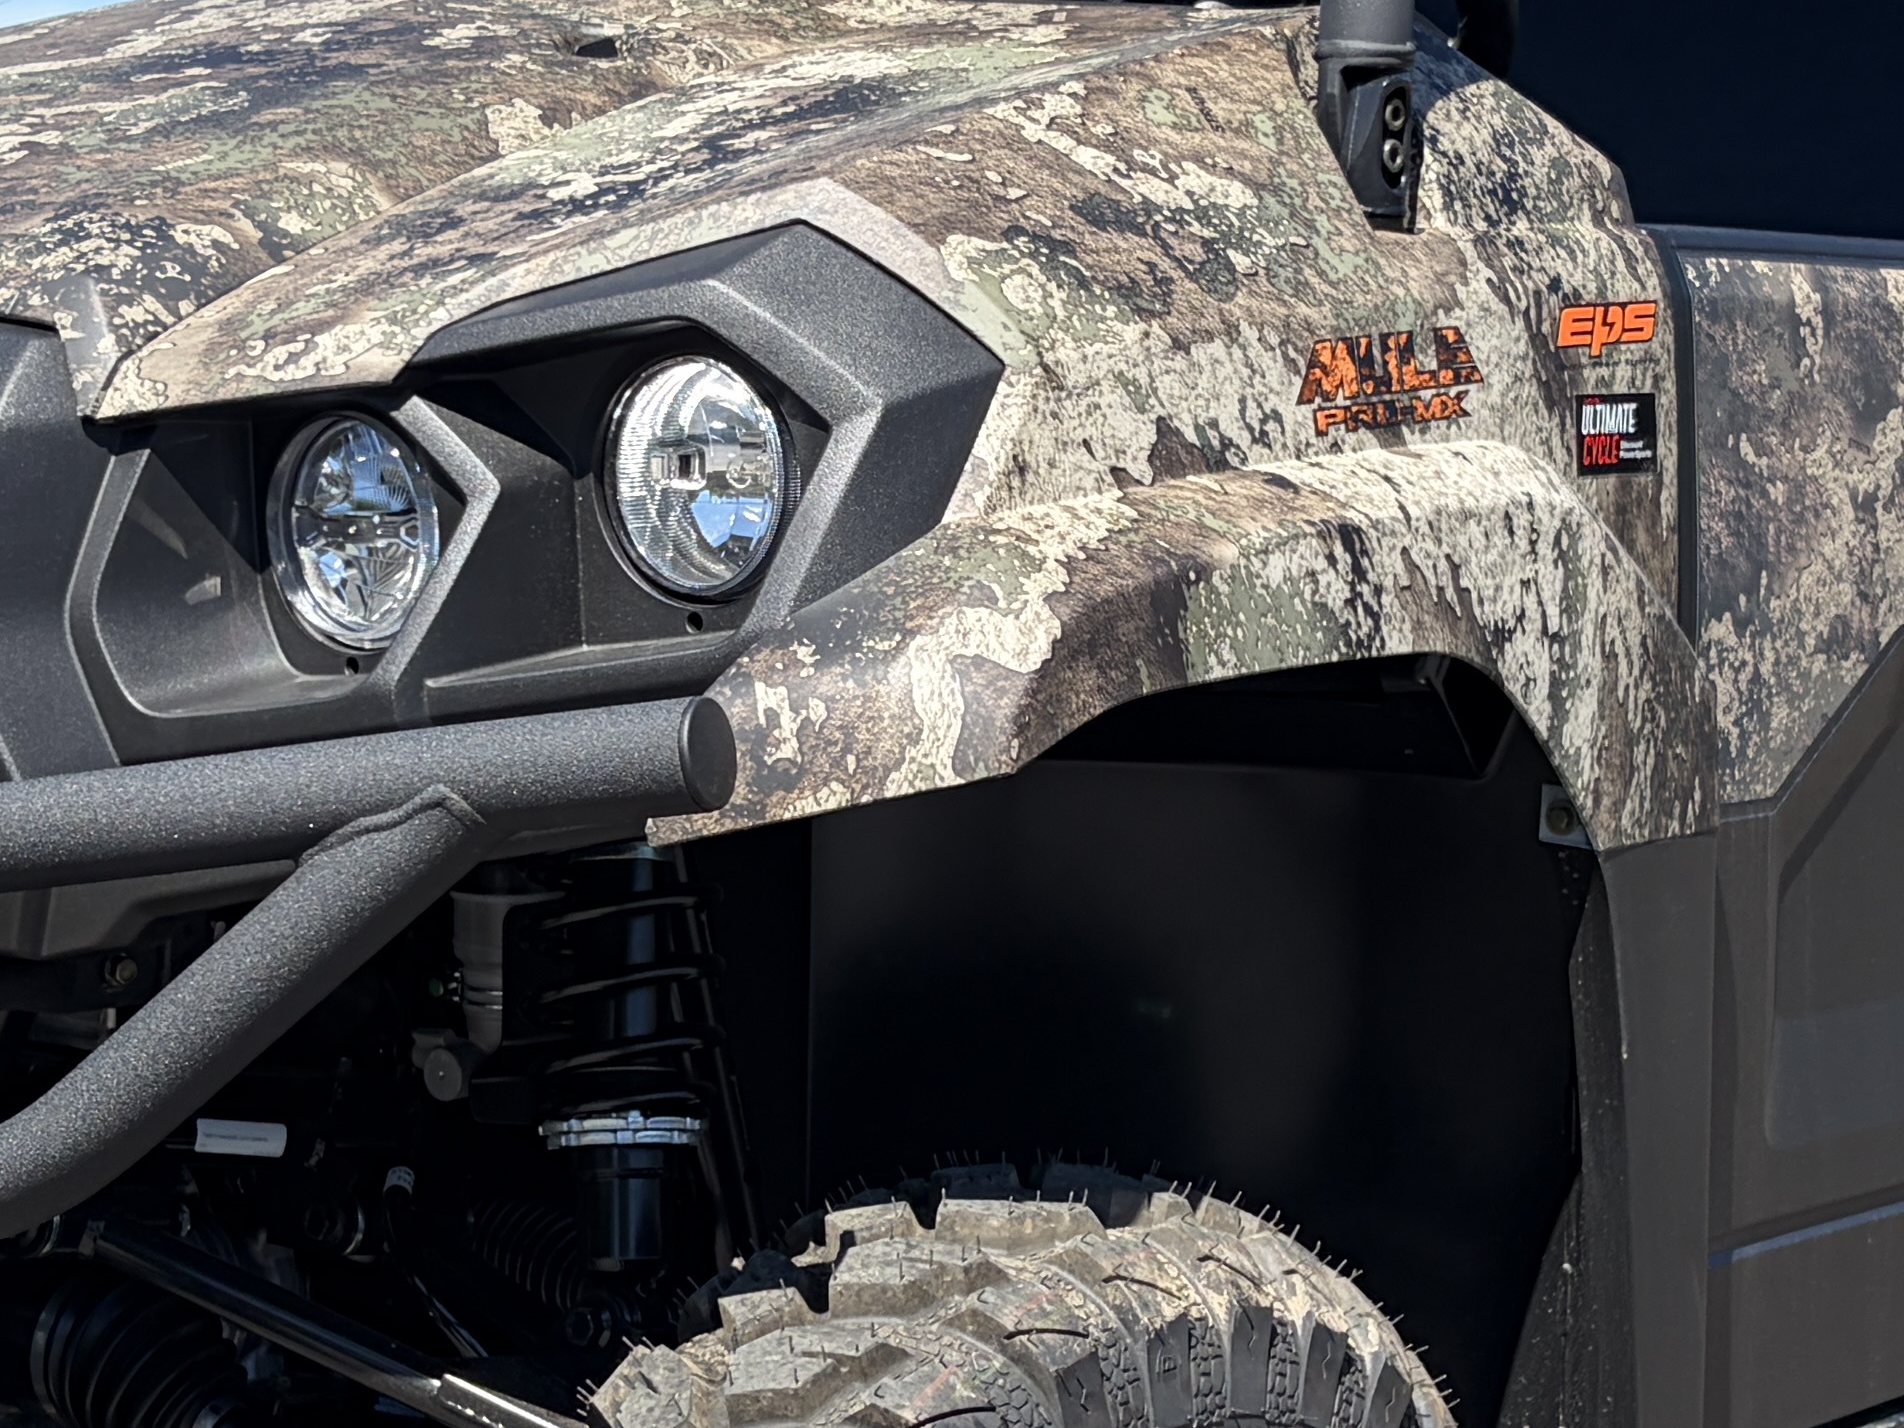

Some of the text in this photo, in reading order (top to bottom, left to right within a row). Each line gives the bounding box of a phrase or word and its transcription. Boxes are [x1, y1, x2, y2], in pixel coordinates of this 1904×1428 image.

[1296, 326, 1484, 405] MULE
[1581, 402, 1638, 435] ULTIMATE
[1583, 435, 1619, 466] CYCLE
